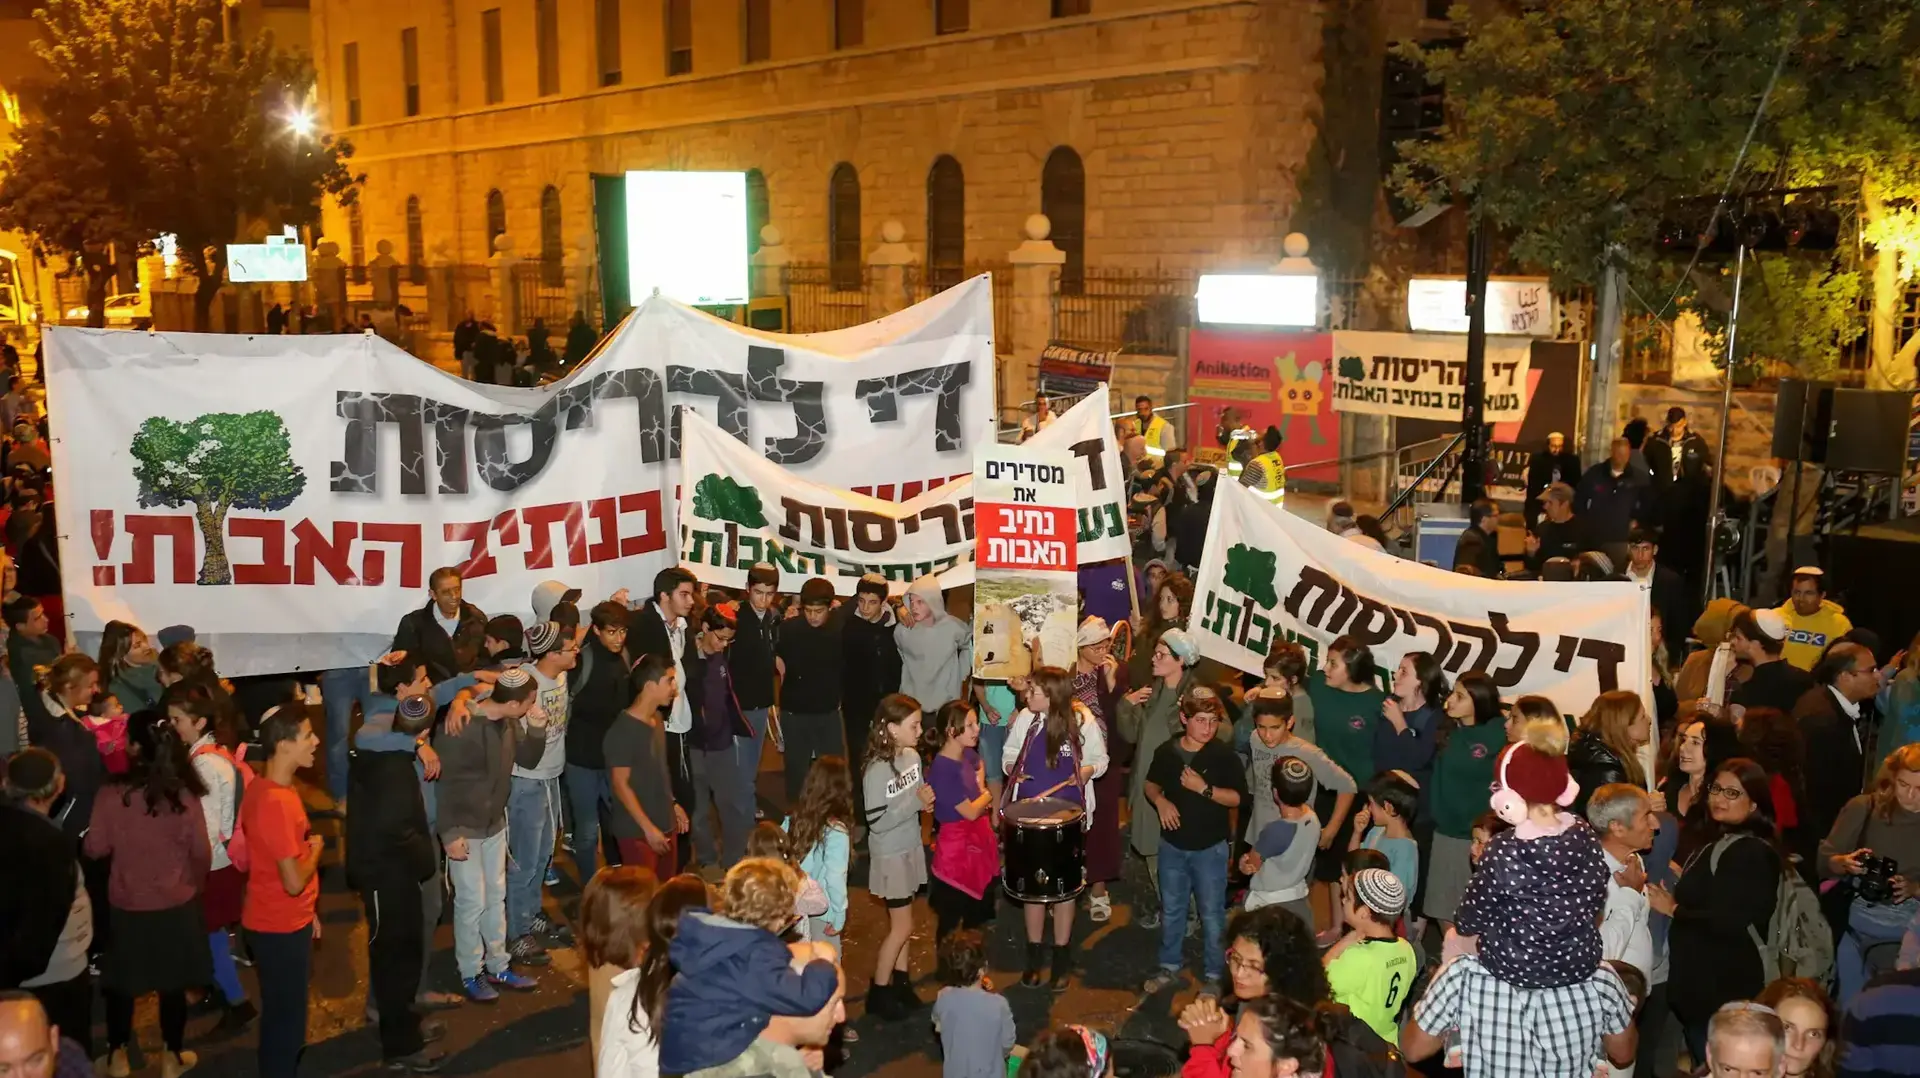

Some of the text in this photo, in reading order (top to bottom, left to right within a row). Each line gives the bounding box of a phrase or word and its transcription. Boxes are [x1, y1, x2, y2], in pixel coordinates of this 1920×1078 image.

[1195, 360, 1271, 379] AniNation
[1369, 355, 1519, 387] די הריסות
[329, 344, 971, 495] די להריסות
[985, 460, 1065, 485] מסדירים
[1013, 486, 1037, 503] את
[443, 489, 668, 580] בנתיב
[999, 508, 1055, 536] נתיב
[986, 537, 1067, 566] האבות
[1553, 634, 1626, 693] די
[1385, 971, 1402, 1009] 6
